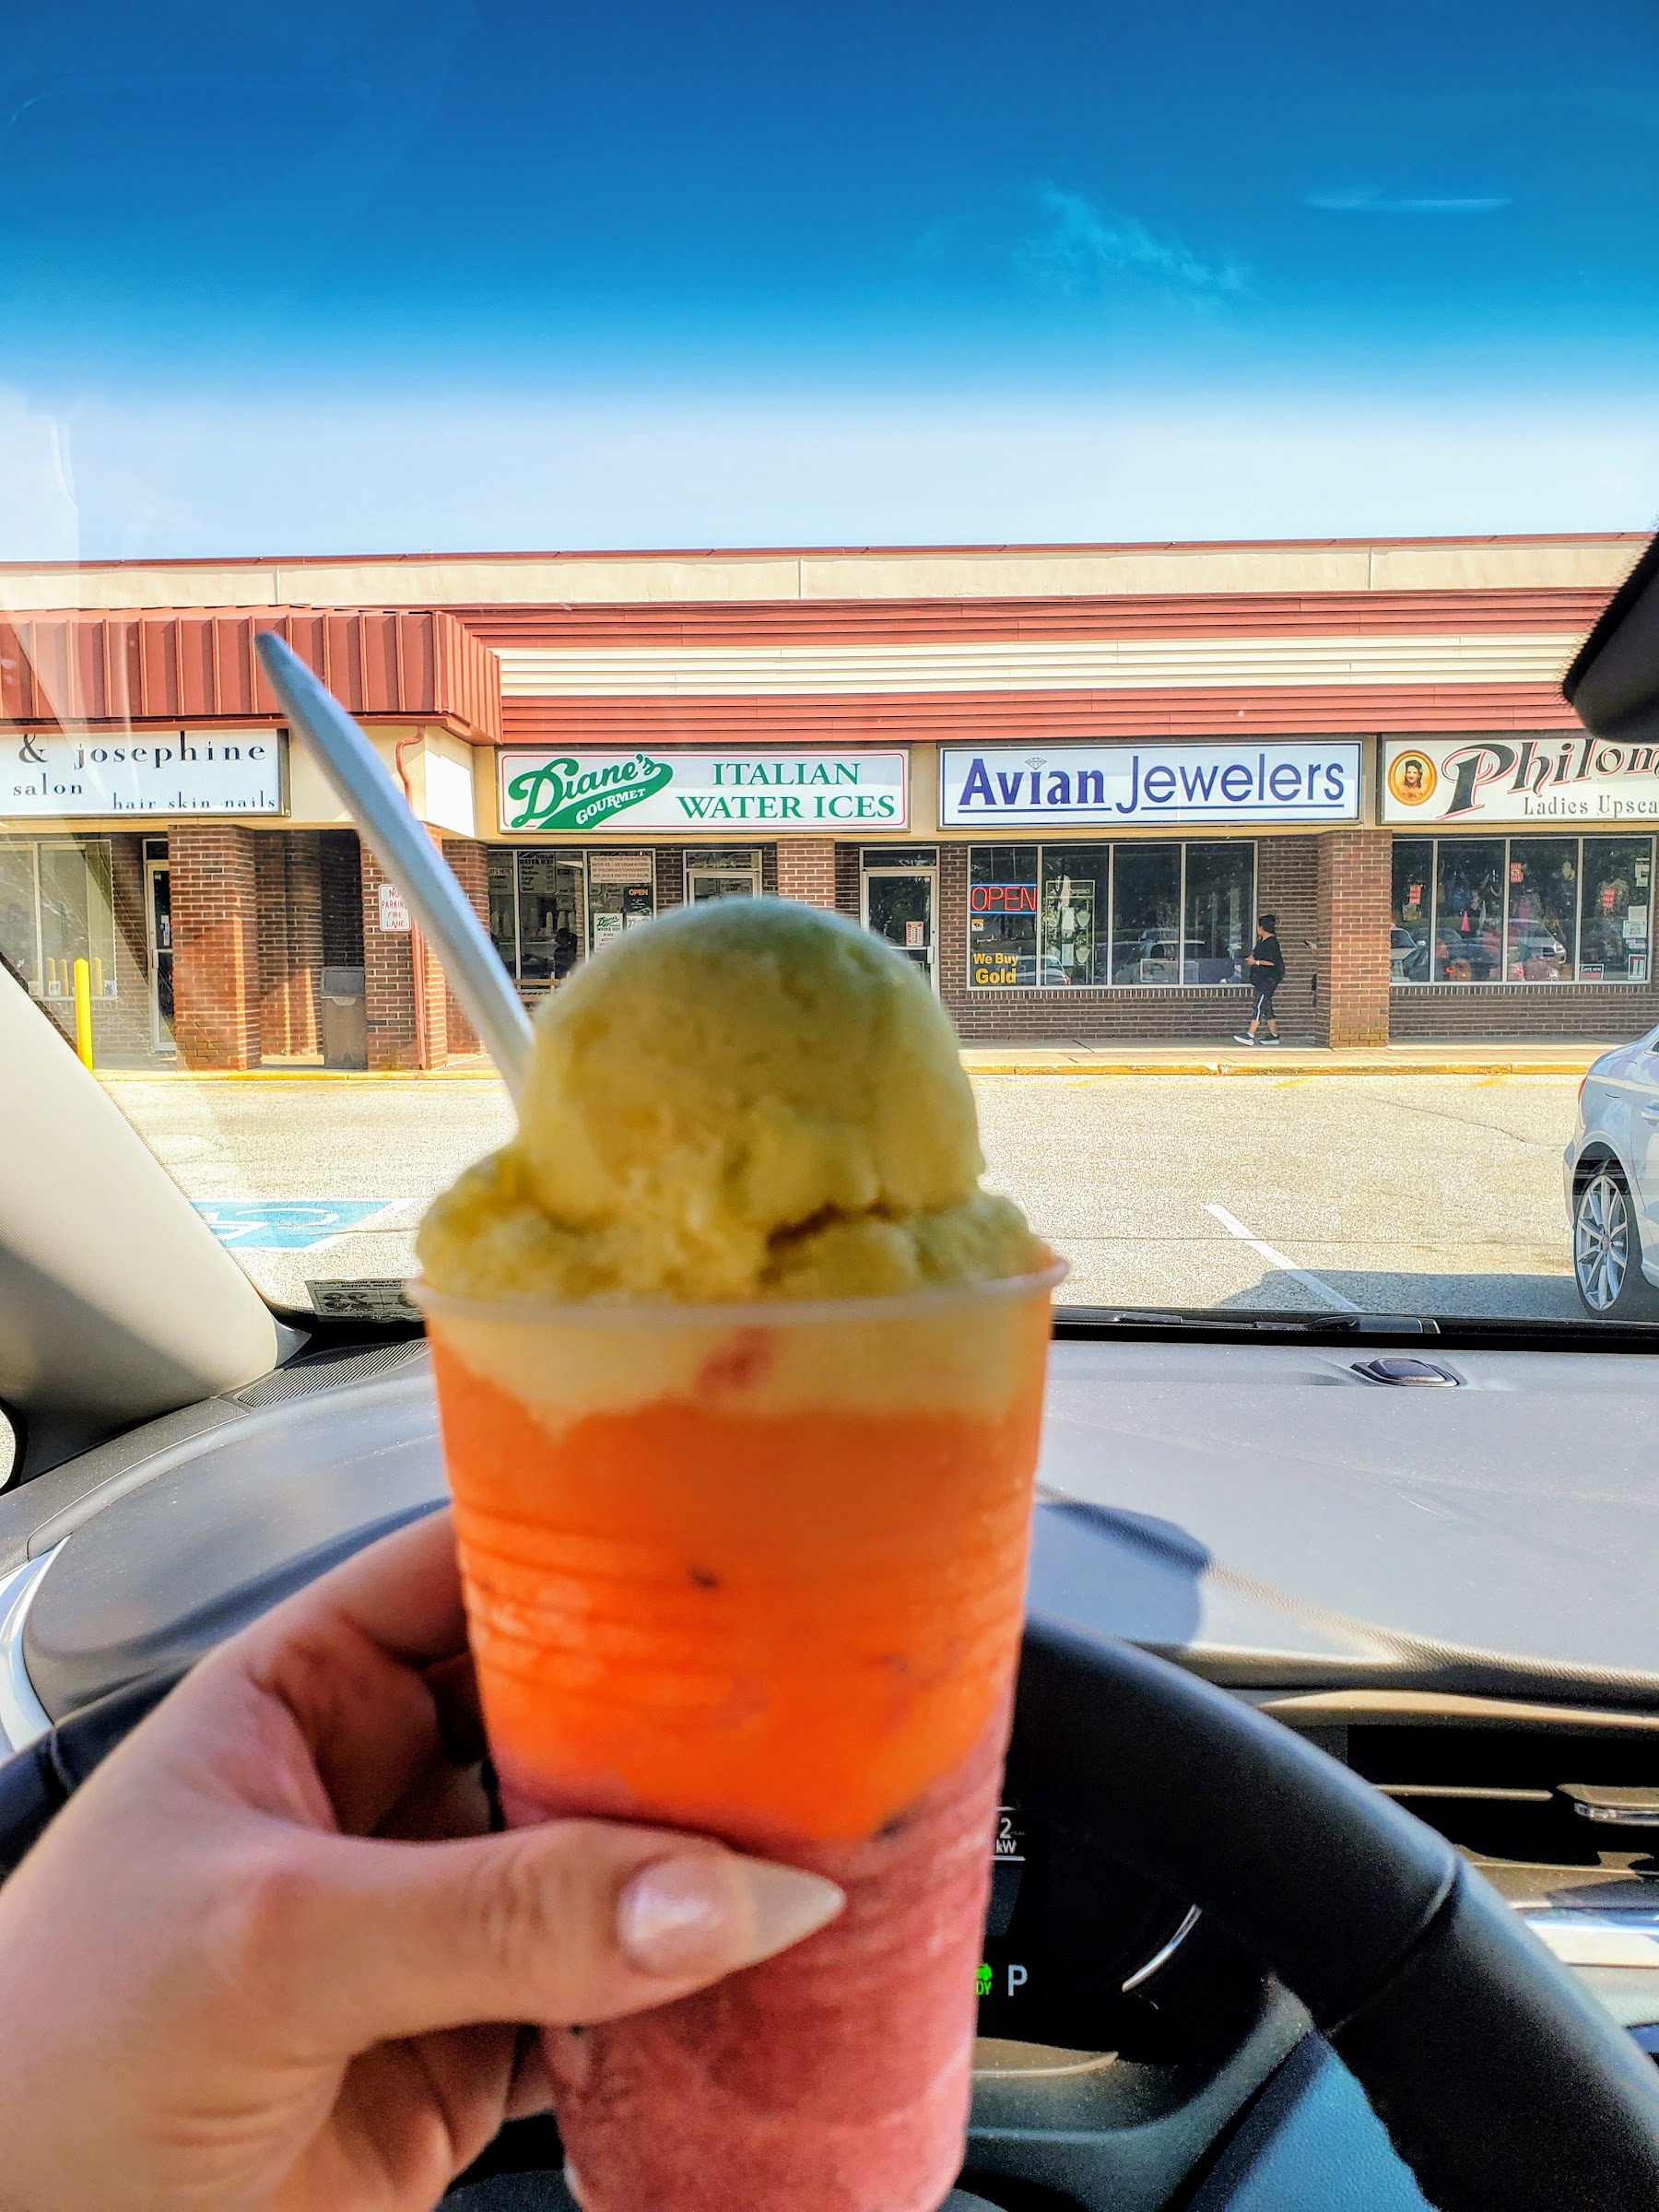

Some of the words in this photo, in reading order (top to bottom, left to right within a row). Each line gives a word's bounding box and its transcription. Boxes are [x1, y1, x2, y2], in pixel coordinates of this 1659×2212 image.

[74, 730, 266, 770] josephine
[13, 772, 84, 796] salon
[712, 763, 862, 785] ITALIAN
[957, 758, 1105, 806] Avian
[1115, 753, 1345, 814] Jewelers
[112, 792, 157, 810] hair
[168, 791, 211, 808] skin
[224, 790, 276, 808] nails
[508, 753, 658, 829] Diane's
[575, 787, 647, 825] GOURMET
[676, 795, 805, 819] WATER
[813, 795, 895, 818] ICES
[1524, 796, 1588, 816] Ladies
[382, 900, 406, 910] PARKIN
[388, 888, 400, 899] NO
[971, 887, 1037, 912] OPEN
[973, 953, 993, 964] We
[994, 952, 1018, 967] Buy
[975, 968, 1017, 984] Gold
[996, 1838, 1018, 1854] kW
[1007, 1964, 1029, 1996] P
